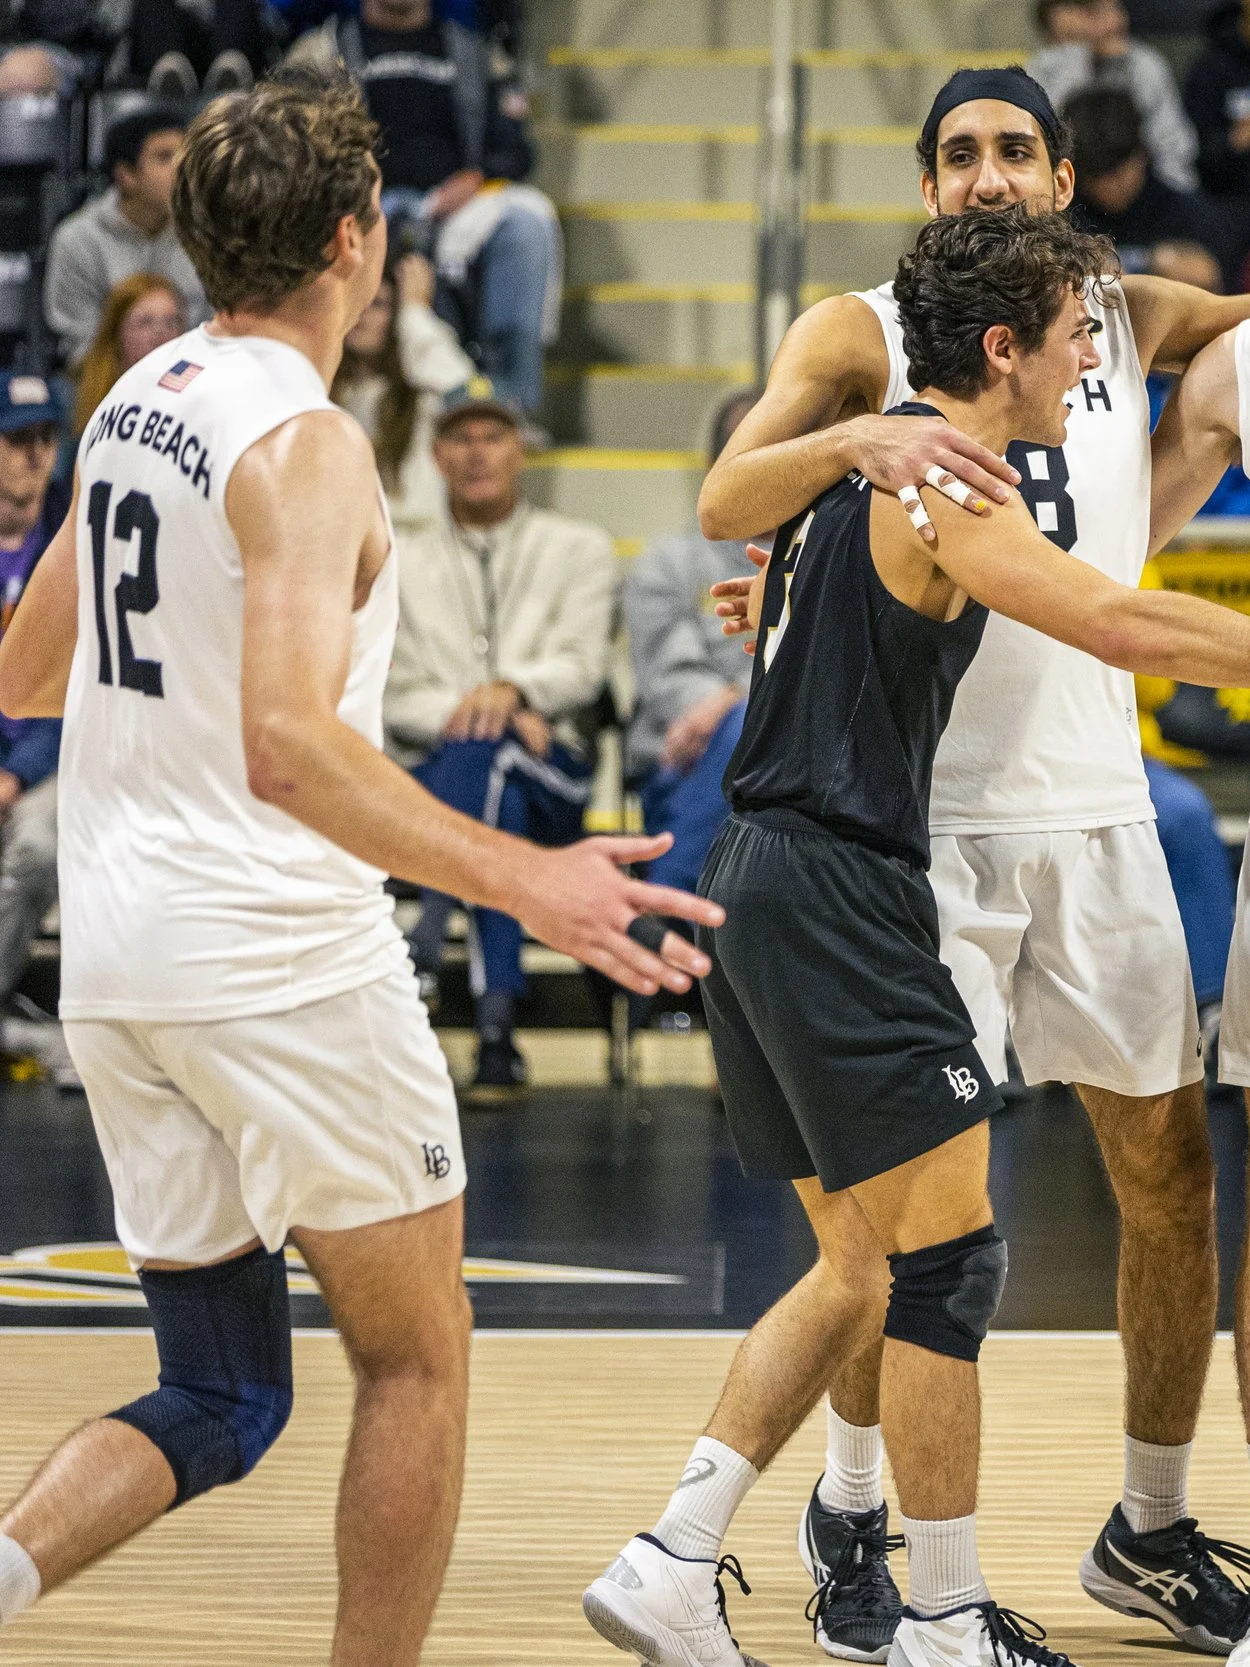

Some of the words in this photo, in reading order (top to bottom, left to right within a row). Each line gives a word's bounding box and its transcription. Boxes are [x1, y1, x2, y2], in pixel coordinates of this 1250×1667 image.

[139, 410, 214, 500] BEACH
[1005, 438, 1078, 553] 8
[88, 479, 165, 699] 12
